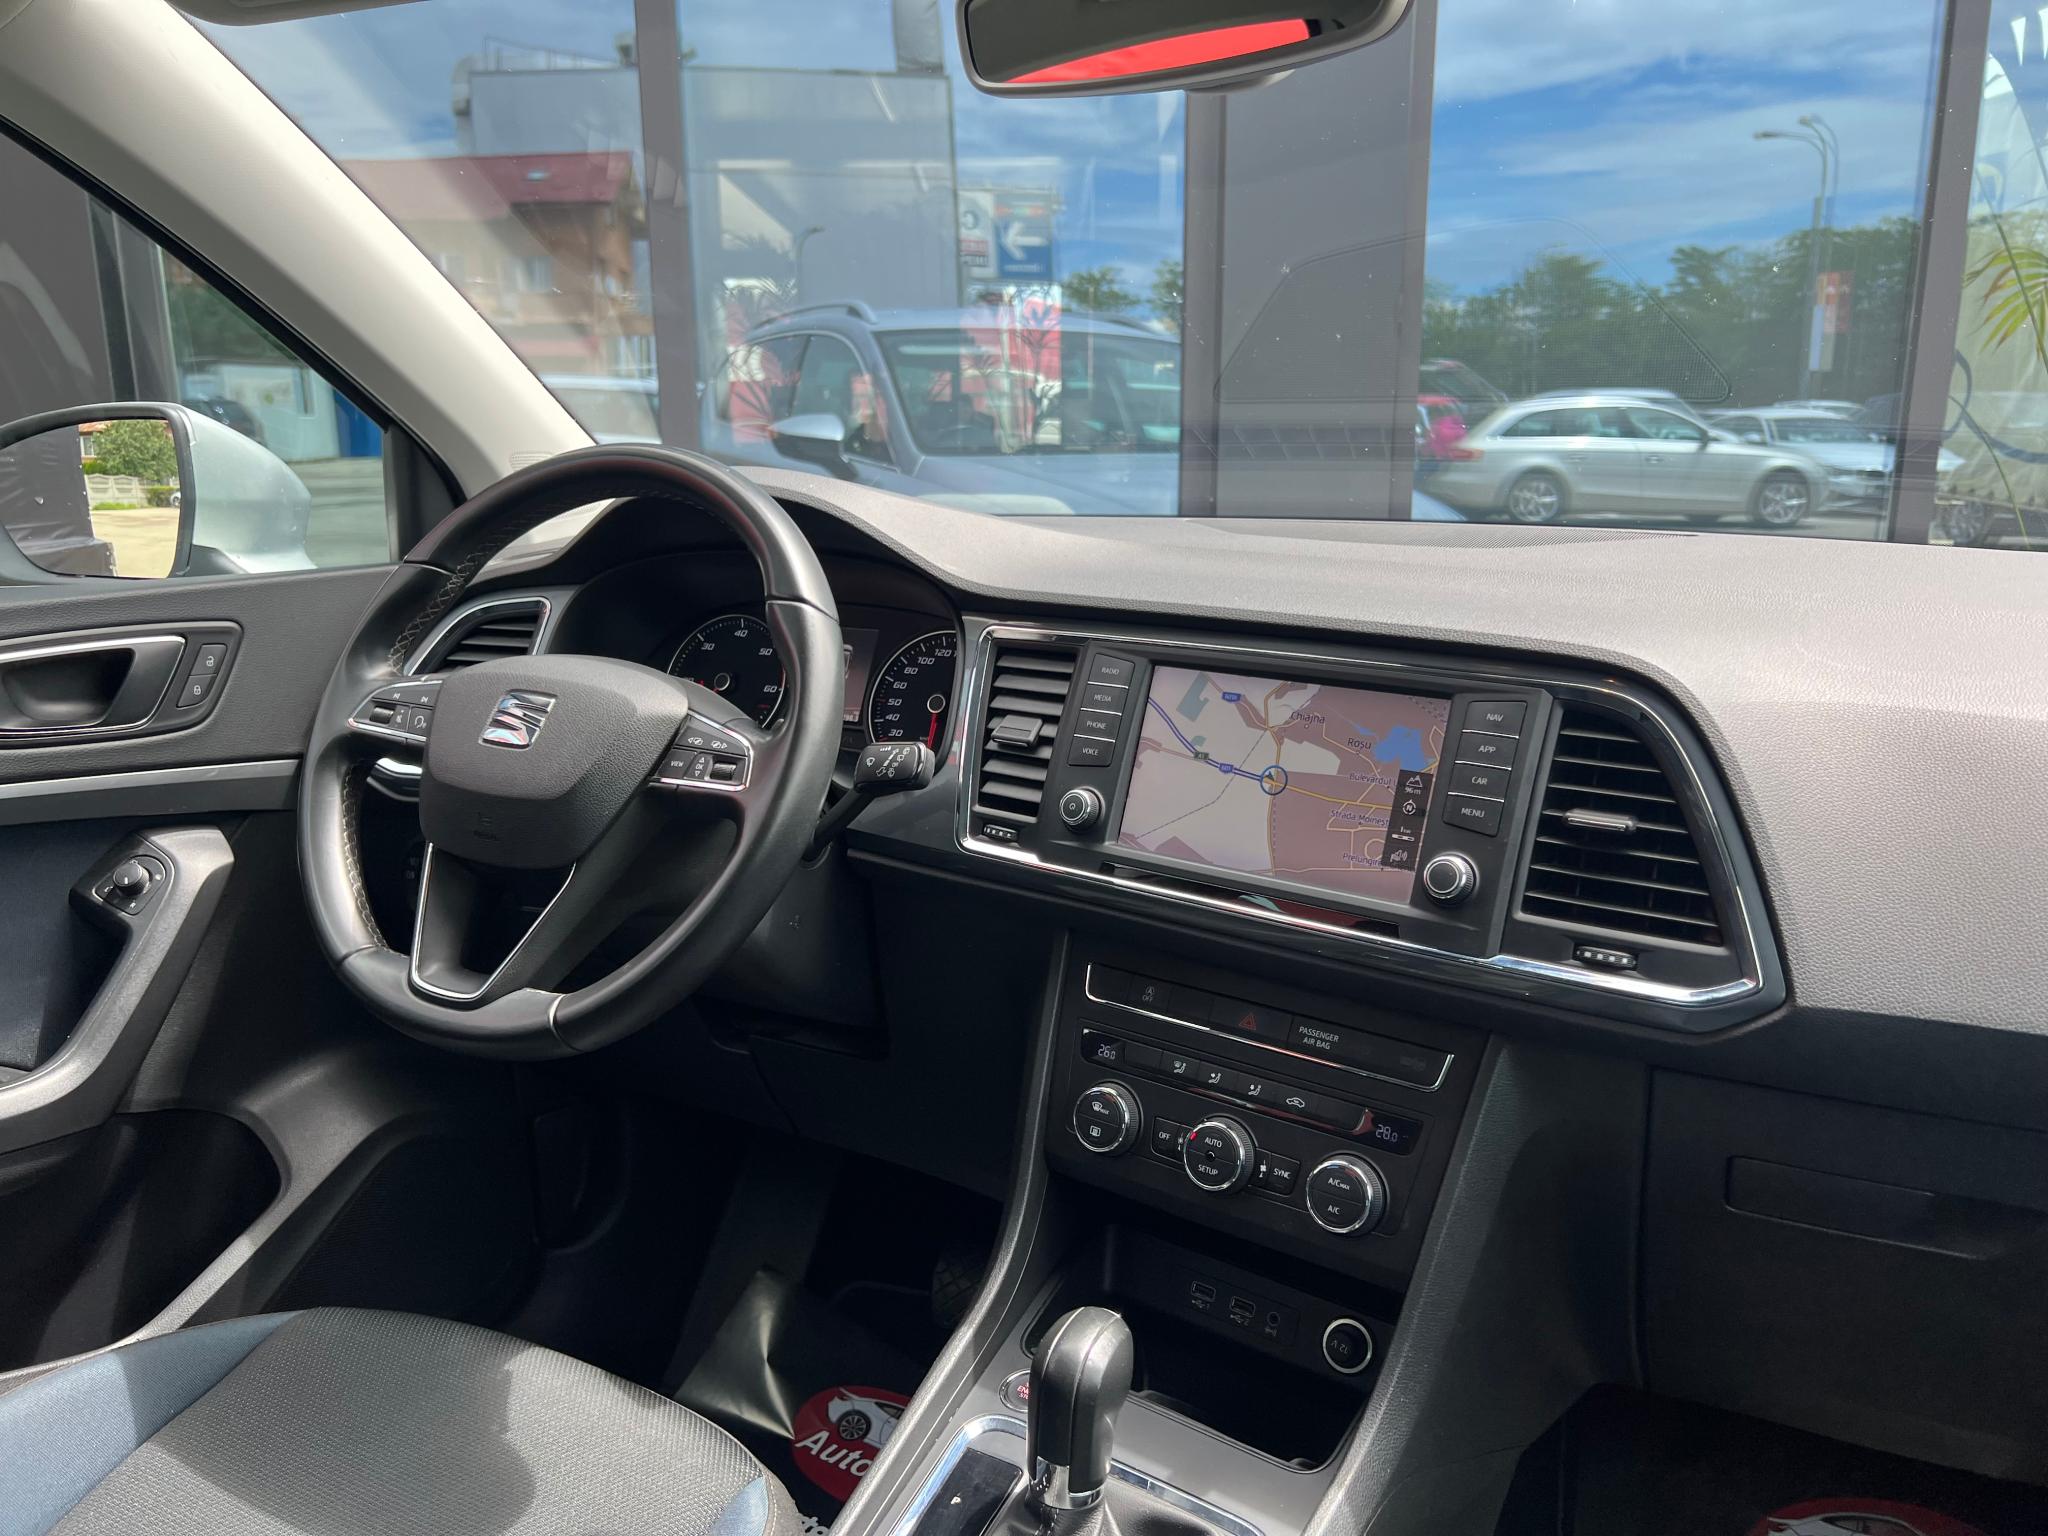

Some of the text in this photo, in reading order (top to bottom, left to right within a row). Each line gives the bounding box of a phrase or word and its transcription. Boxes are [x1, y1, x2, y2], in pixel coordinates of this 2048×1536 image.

[734, 629, 749, 638] 40
[701, 643, 715, 651] 30
[758, 648, 773, 656] 50
[934, 649, 952, 657] 120
[917, 656, 935, 665] 100
[903, 667, 919, 675] 80
[1101, 667, 1120, 676] RADIO
[763, 685, 778, 693] 60
[893, 681, 908, 690] 60
[887, 698, 903, 706] 50
[1093, 694, 1112, 702] MEDIA
[885, 713, 901, 721] 40
[1290, 711, 1326, 724] Chiajna
[1486, 713, 1504, 722] NAV
[1086, 720, 1107, 729] PHONE
[888, 729, 904, 737] 30
[1082, 747, 1099, 756] VOICE
[1478, 745, 1497, 753] APP
[1471, 776, 1488, 785] CAR
[1461, 807, 1486, 818] MENU
[1298, 1026, 1339, 1042] PASSENGER
[1302, 1036, 1331, 1050] AIR BAG
[1159, 1132, 1171, 1141] OFF
[1204, 1137, 1222, 1148] AUTO
[1198, 1164, 1219, 1176] SETUP
[1273, 1168, 1292, 1180] SYNC
[1327, 1204, 1340, 1215] A/C
